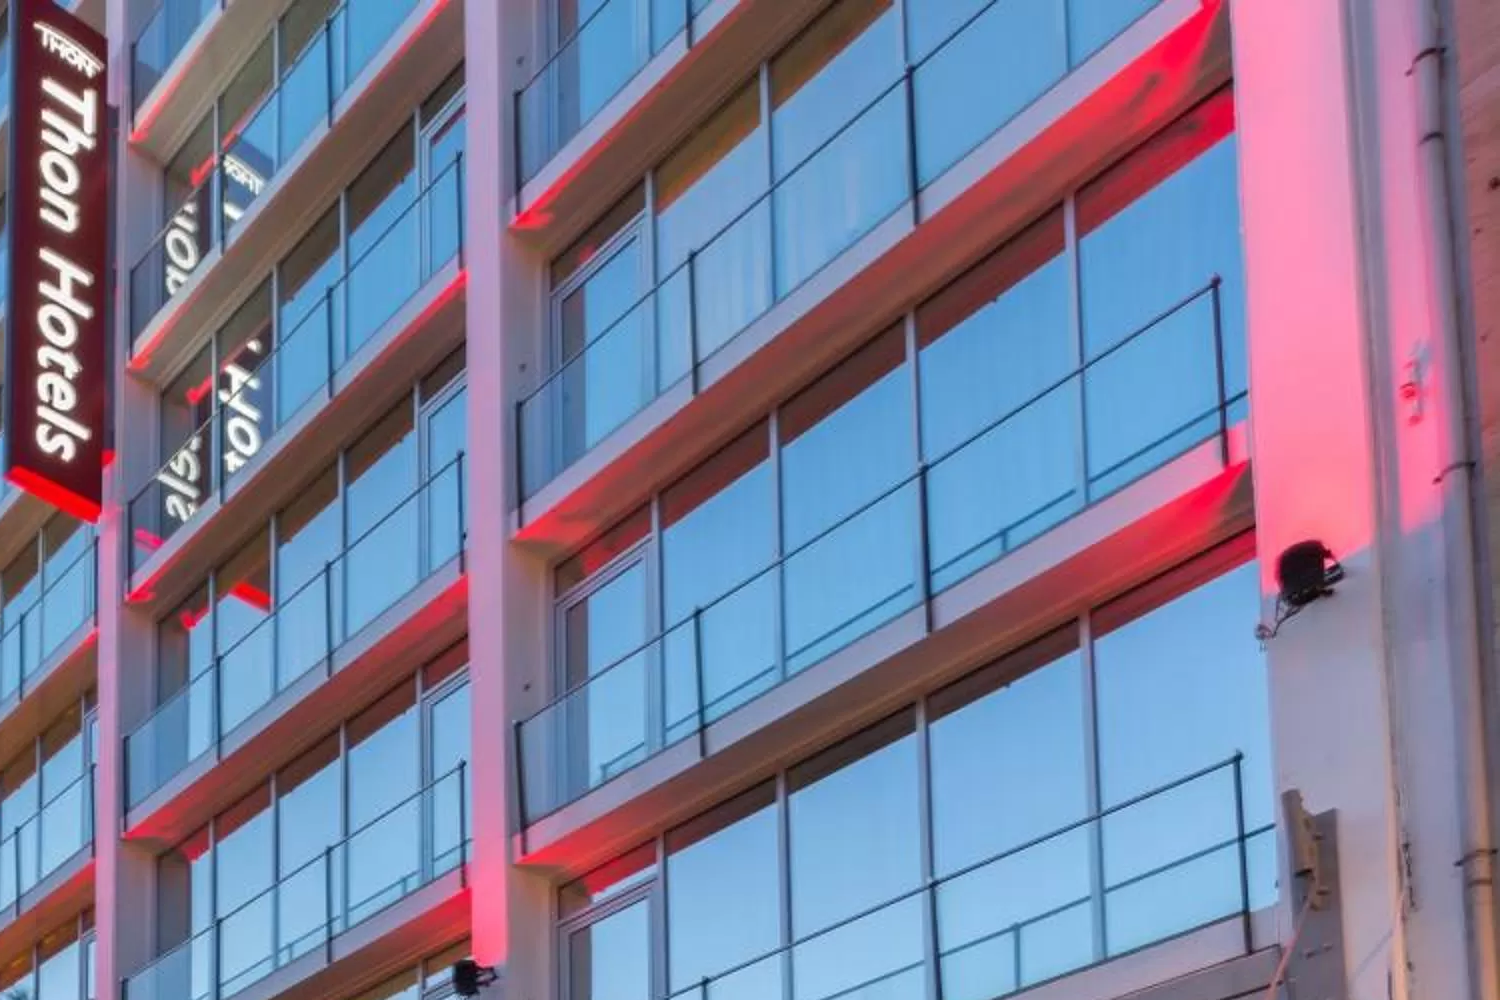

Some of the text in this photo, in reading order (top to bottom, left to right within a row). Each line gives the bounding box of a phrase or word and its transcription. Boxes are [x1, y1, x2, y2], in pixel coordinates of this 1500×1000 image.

[33, 22, 104, 78] THON
[35, 77, 97, 464] Thon Hotels
